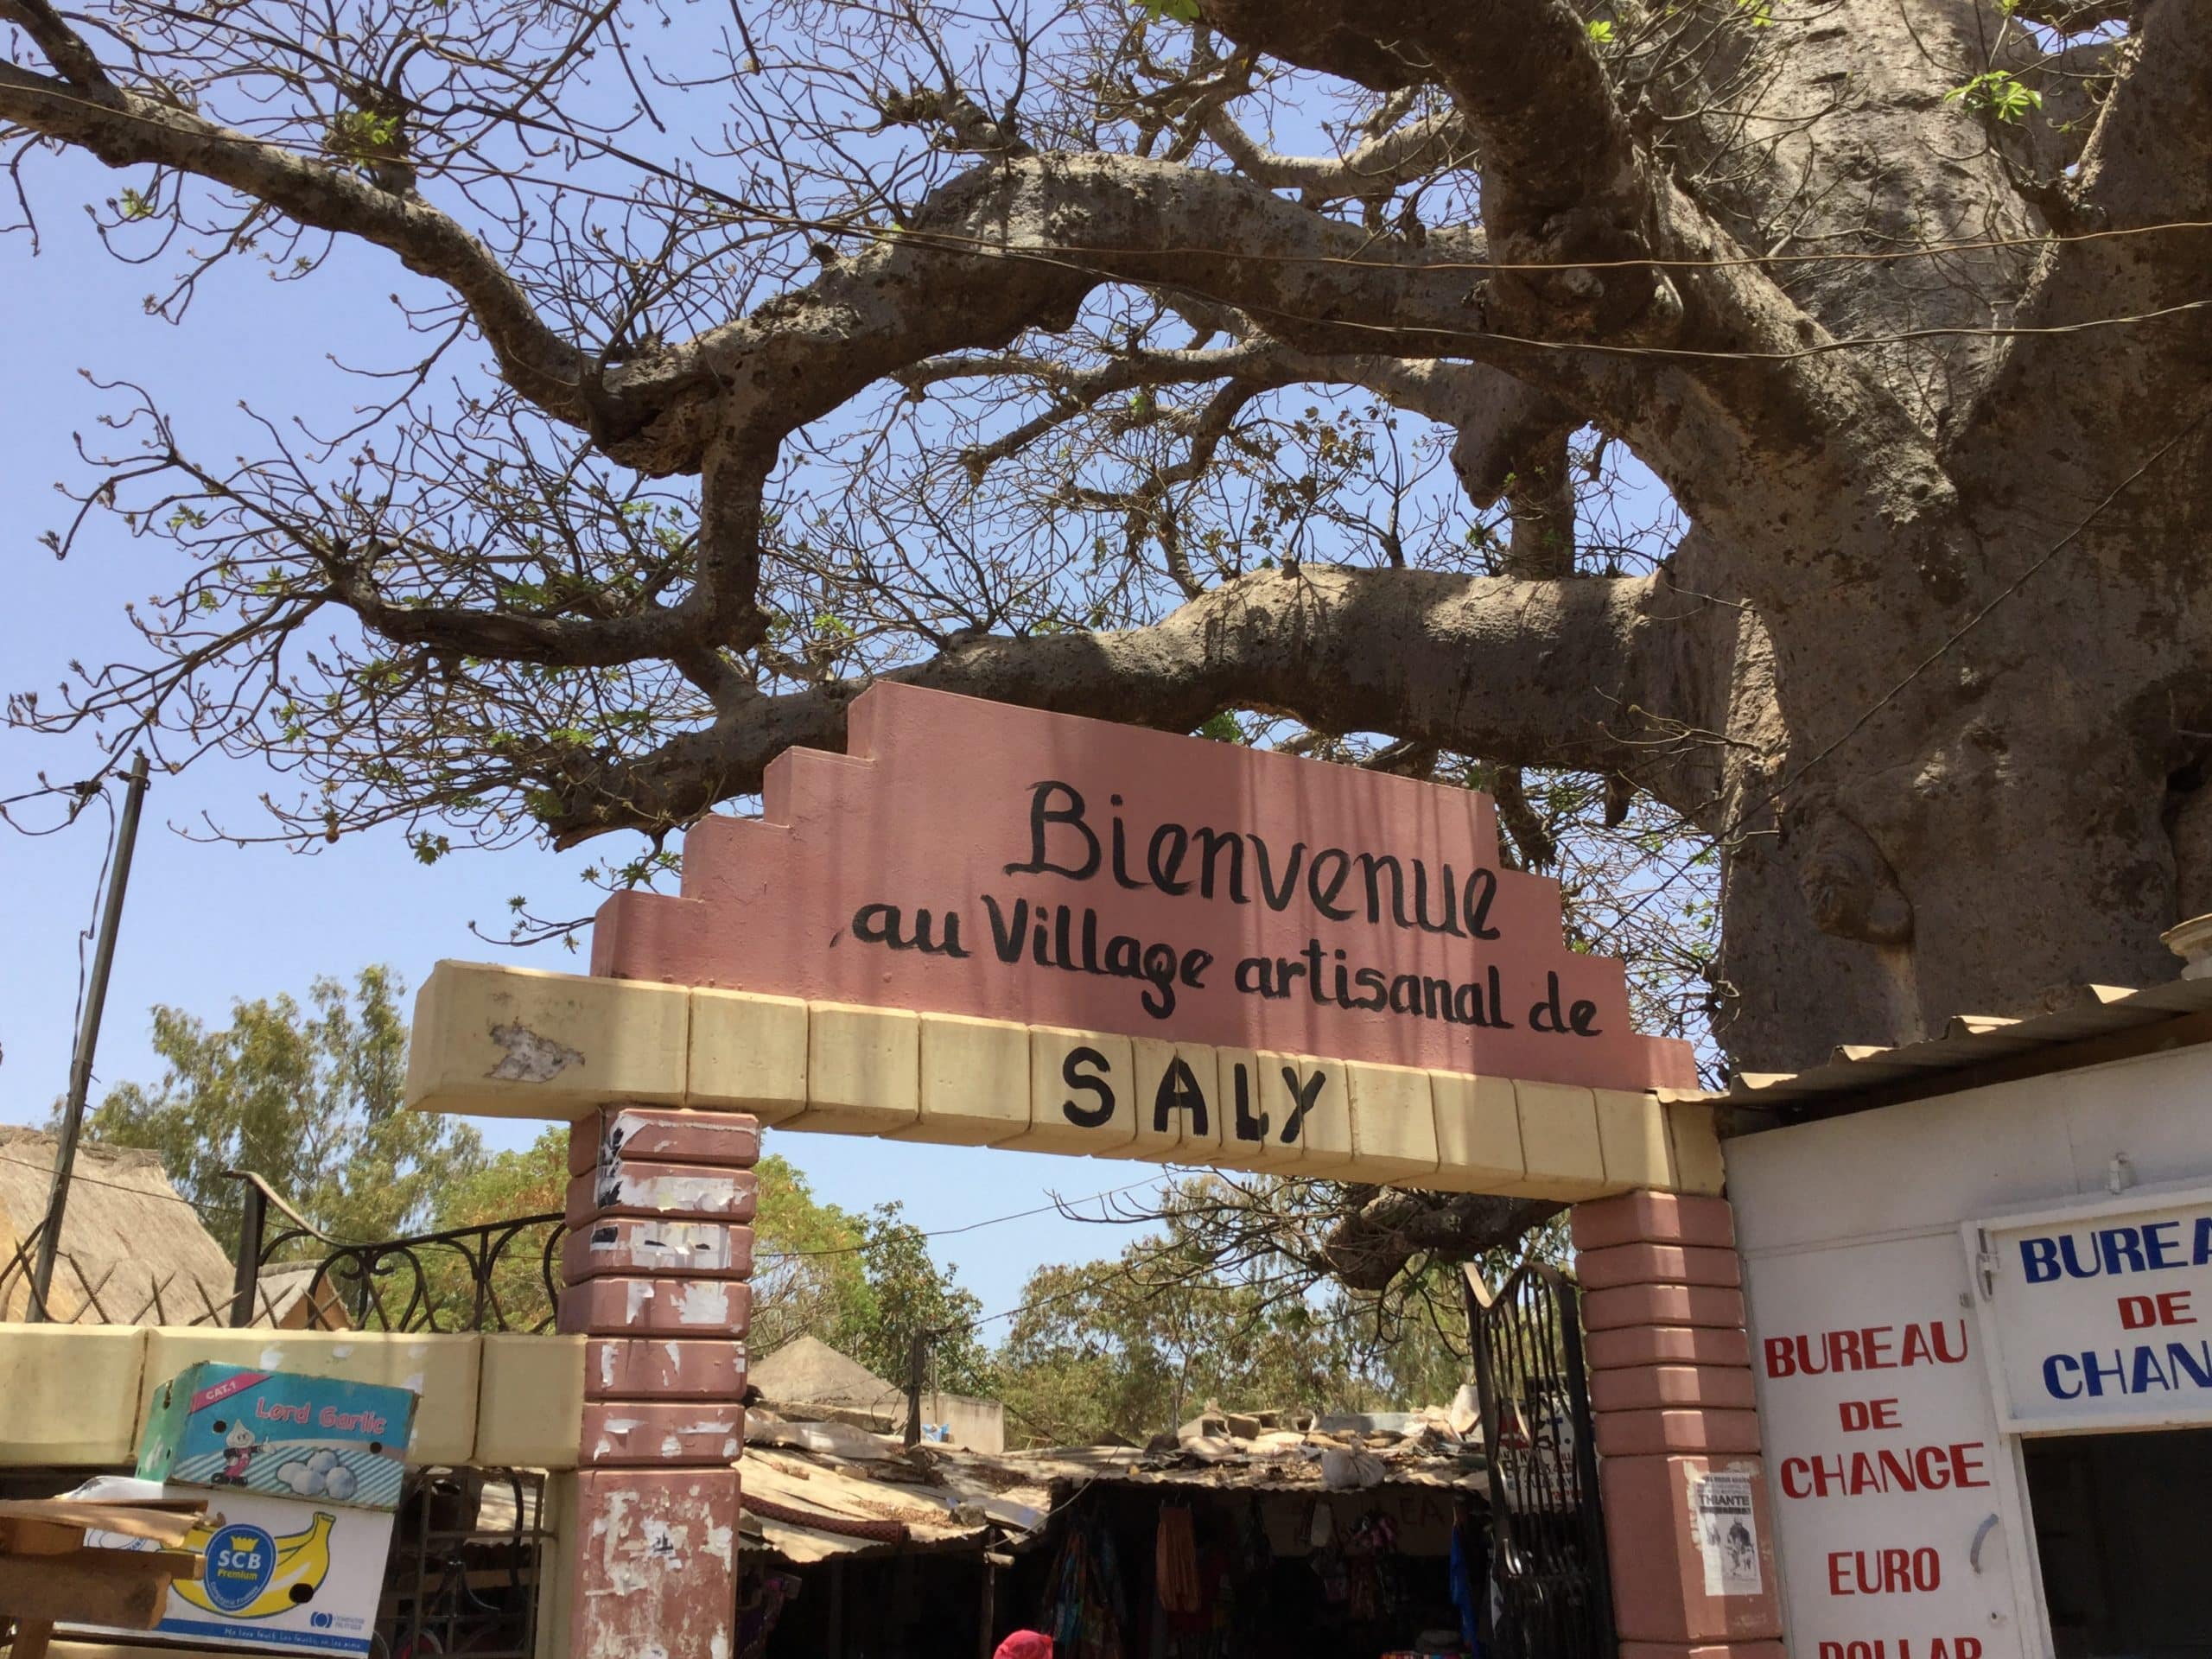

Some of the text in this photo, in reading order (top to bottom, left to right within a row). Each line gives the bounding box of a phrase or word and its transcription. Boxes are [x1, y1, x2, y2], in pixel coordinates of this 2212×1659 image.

[1003, 780, 1500, 939] Bienvenue
[852, 894, 1603, 1036] au Village artisanal de
[1063, 1046, 1325, 1142] SALY
[2117, 1291, 2197, 1330] DE
[1764, 1319, 1968, 1378] BUREAU
[2043, 1340, 2212, 1400] CHAN
[205, 1381, 237, 1401] CAT.1
[257, 1396, 387, 1434] Lord Garlic
[1839, 1398, 1902, 1432] DE
[1780, 1442, 1990, 1498] CHANGE
[217, 1549, 261, 1570] SCB
[217, 1568, 258, 1580] Premium
[1827, 1547, 1941, 1595] EURO
